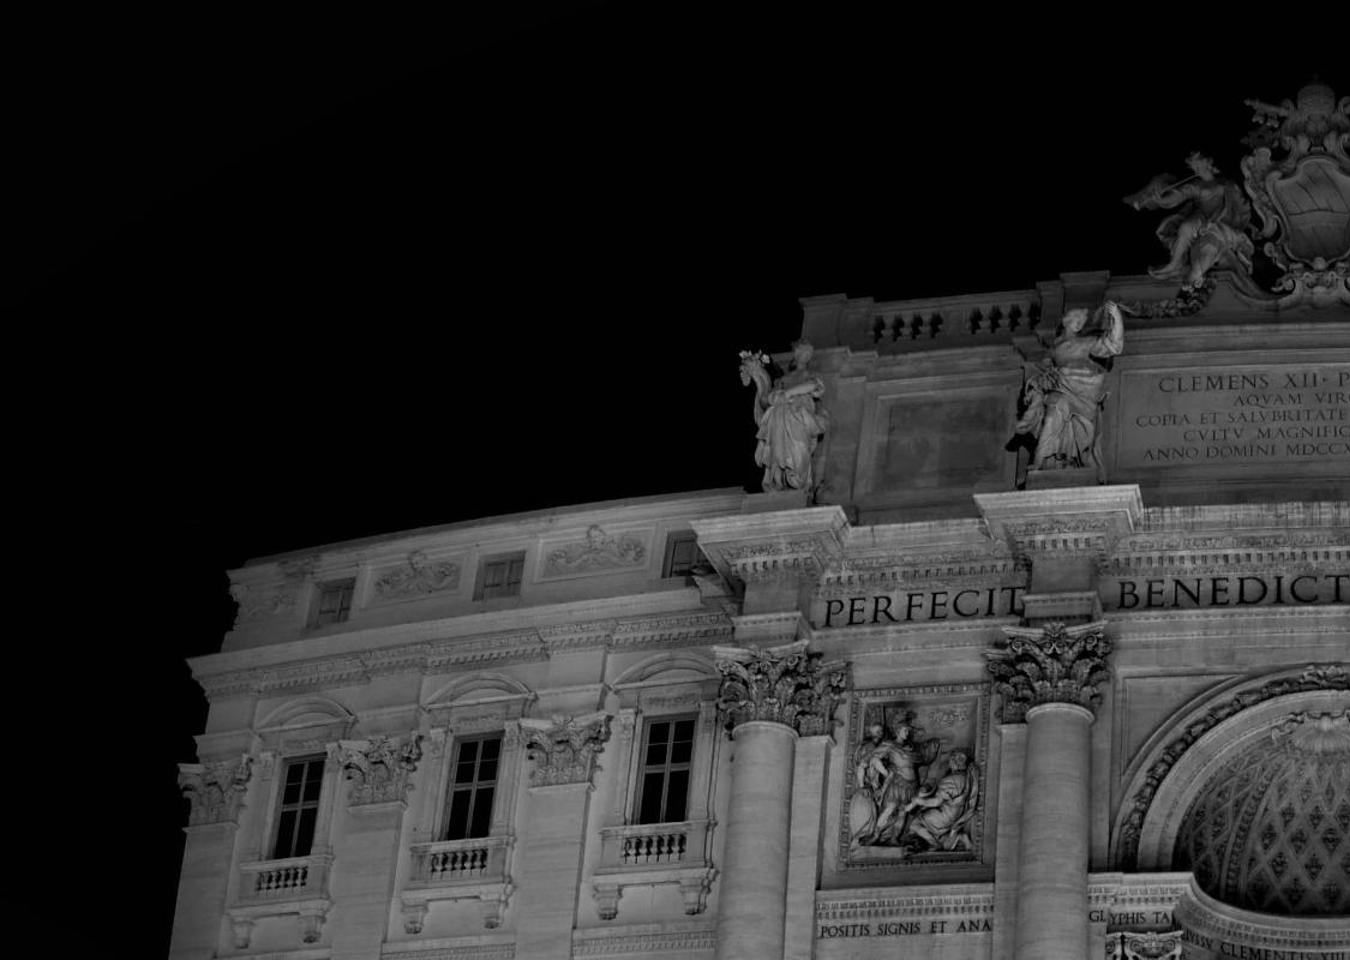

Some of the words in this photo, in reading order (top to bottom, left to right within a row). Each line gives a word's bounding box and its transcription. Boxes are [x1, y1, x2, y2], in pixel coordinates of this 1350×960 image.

[1159, 375, 1269, 392] CLEMENS
[1233, 393, 1302, 409] AQVAM
[1136, 413, 1191, 428] COPIA
[1200, 412, 1217, 425] ET
[1228, 408, 1348, 424] SALVBRITATE
[1144, 447, 1199, 461] ANNO
[1207, 444, 1276, 459] DOMINI
[822, 586, 1026, 628] PERFECIT
[820, 924, 871, 938] POSITIS
[878, 922, 920, 936] SIGNIS
[930, 920, 947, 934] ET
